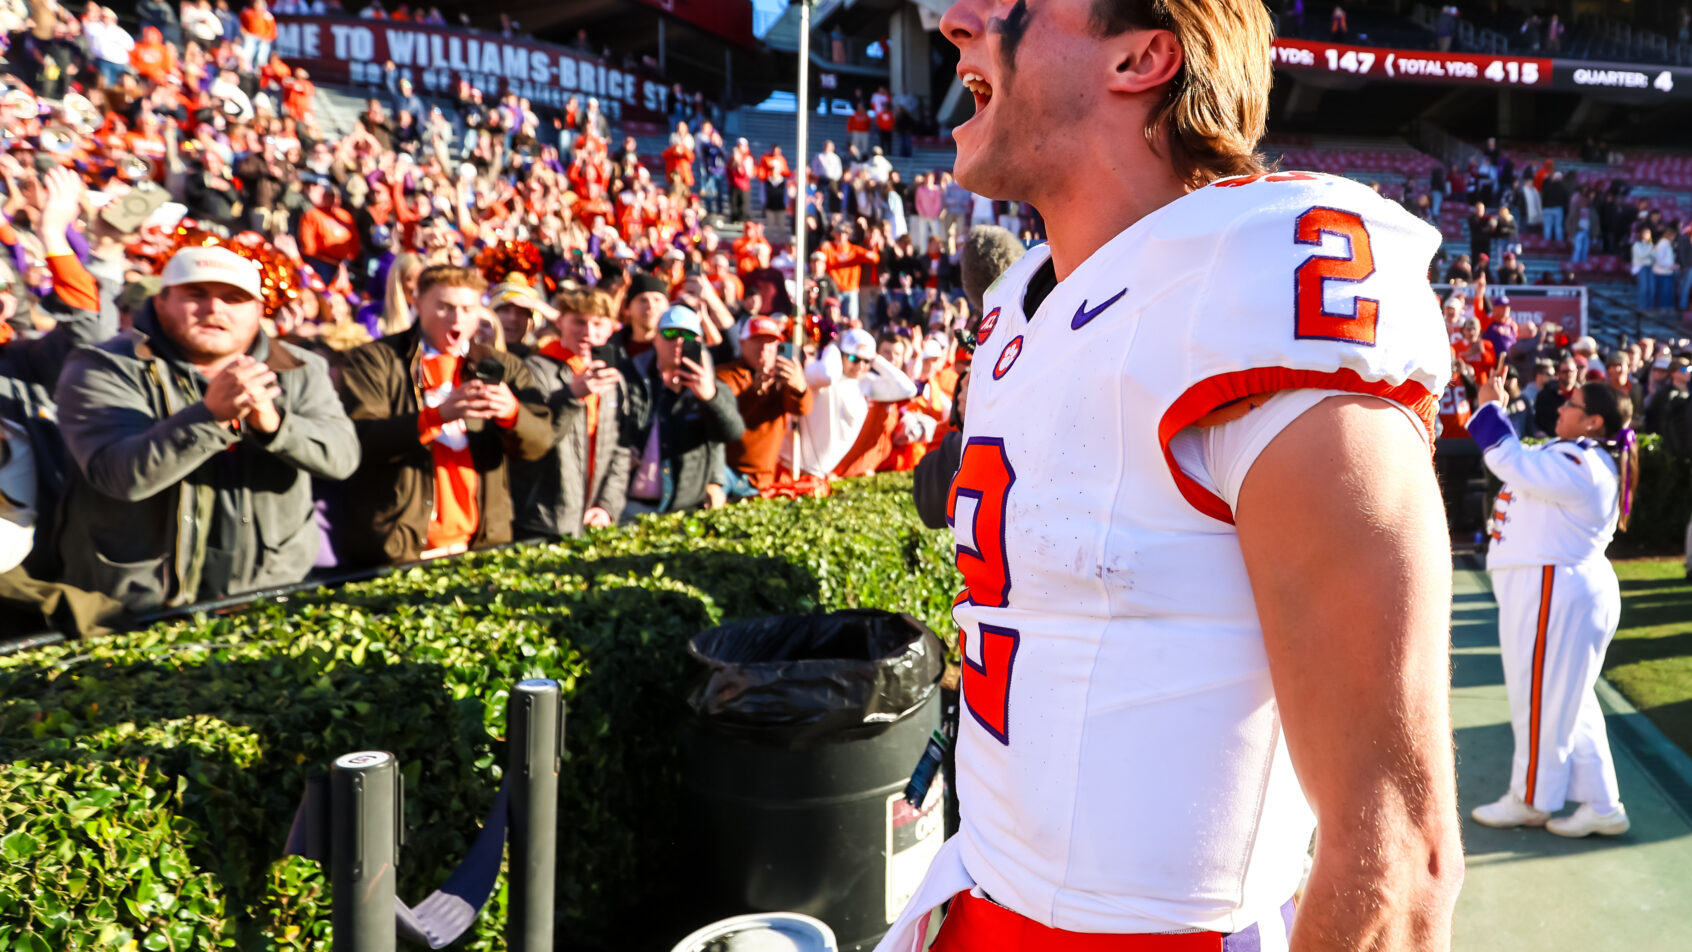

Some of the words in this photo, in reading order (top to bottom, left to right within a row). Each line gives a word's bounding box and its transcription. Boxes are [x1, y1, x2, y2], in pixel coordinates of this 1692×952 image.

[277, 22, 321, 57] ME
[330, 25, 374, 60] TO
[386, 29, 637, 103] WILLIAMS-BRICE
[643, 80, 671, 113] ST
[1325, 49, 1376, 74] 147
[1397, 58, 1445, 76] TOTAL
[1445, 61, 1478, 78] YDS:
[1484, 60, 1539, 84] 415
[1573, 69, 1649, 88] QUARTER:
[1653, 71, 1674, 92] 4
[1294, 205, 1380, 347] 2
[945, 436, 1020, 746] 2
